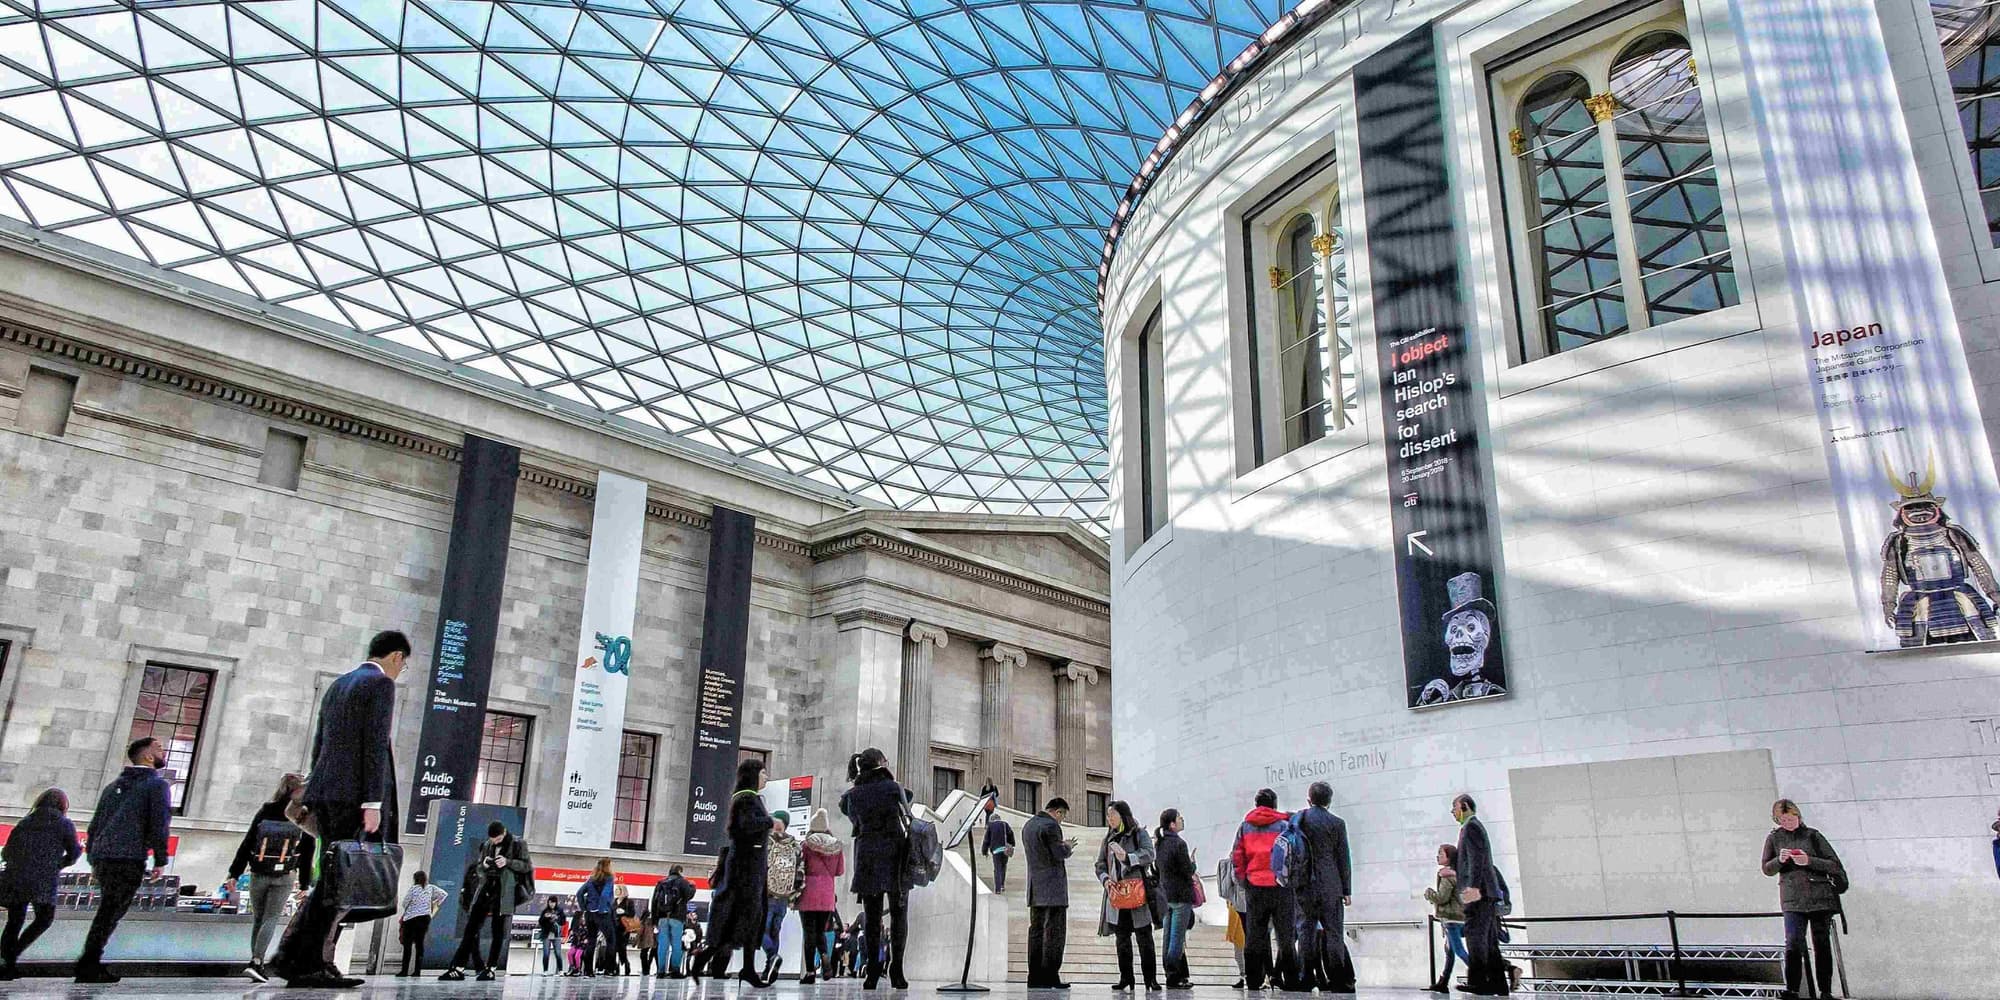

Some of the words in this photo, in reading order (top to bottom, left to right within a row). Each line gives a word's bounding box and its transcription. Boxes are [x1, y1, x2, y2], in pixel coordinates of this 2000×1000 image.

[1165, 28, 1324, 201] ELIZABETH
[1811, 322, 1884, 348] Japan
[1391, 352, 1396, 368] I
[1400, 334, 1448, 364] object
[1814, 358, 1830, 366] The
[1832, 348, 1873, 361] Mitsubishi
[1874, 338, 1924, 352] Corporation
[1816, 360, 1854, 373] Japanese
[1393, 368, 1416, 385] Ian
[1394, 372, 1456, 404] Hislop's
[1396, 394, 1448, 421] search
[1398, 424, 1420, 440] for
[1400, 428, 1457, 458] dissent
[434, 696, 453, 704] British
[453, 698, 477, 707] Museum
[1264, 765, 1284, 784] The
[1288, 758, 1336, 780] Weston
[1340, 747, 1387, 771] Family
[422, 771, 454, 784] Audio
[420, 785, 451, 796] guide
[568, 786, 598, 800] Family
[567, 800, 592, 810] guide
[694, 800, 718, 812] Audio
[692, 812, 716, 822] guide
[454, 818, 466, 846] What's
[460, 806, 467, 816] on
